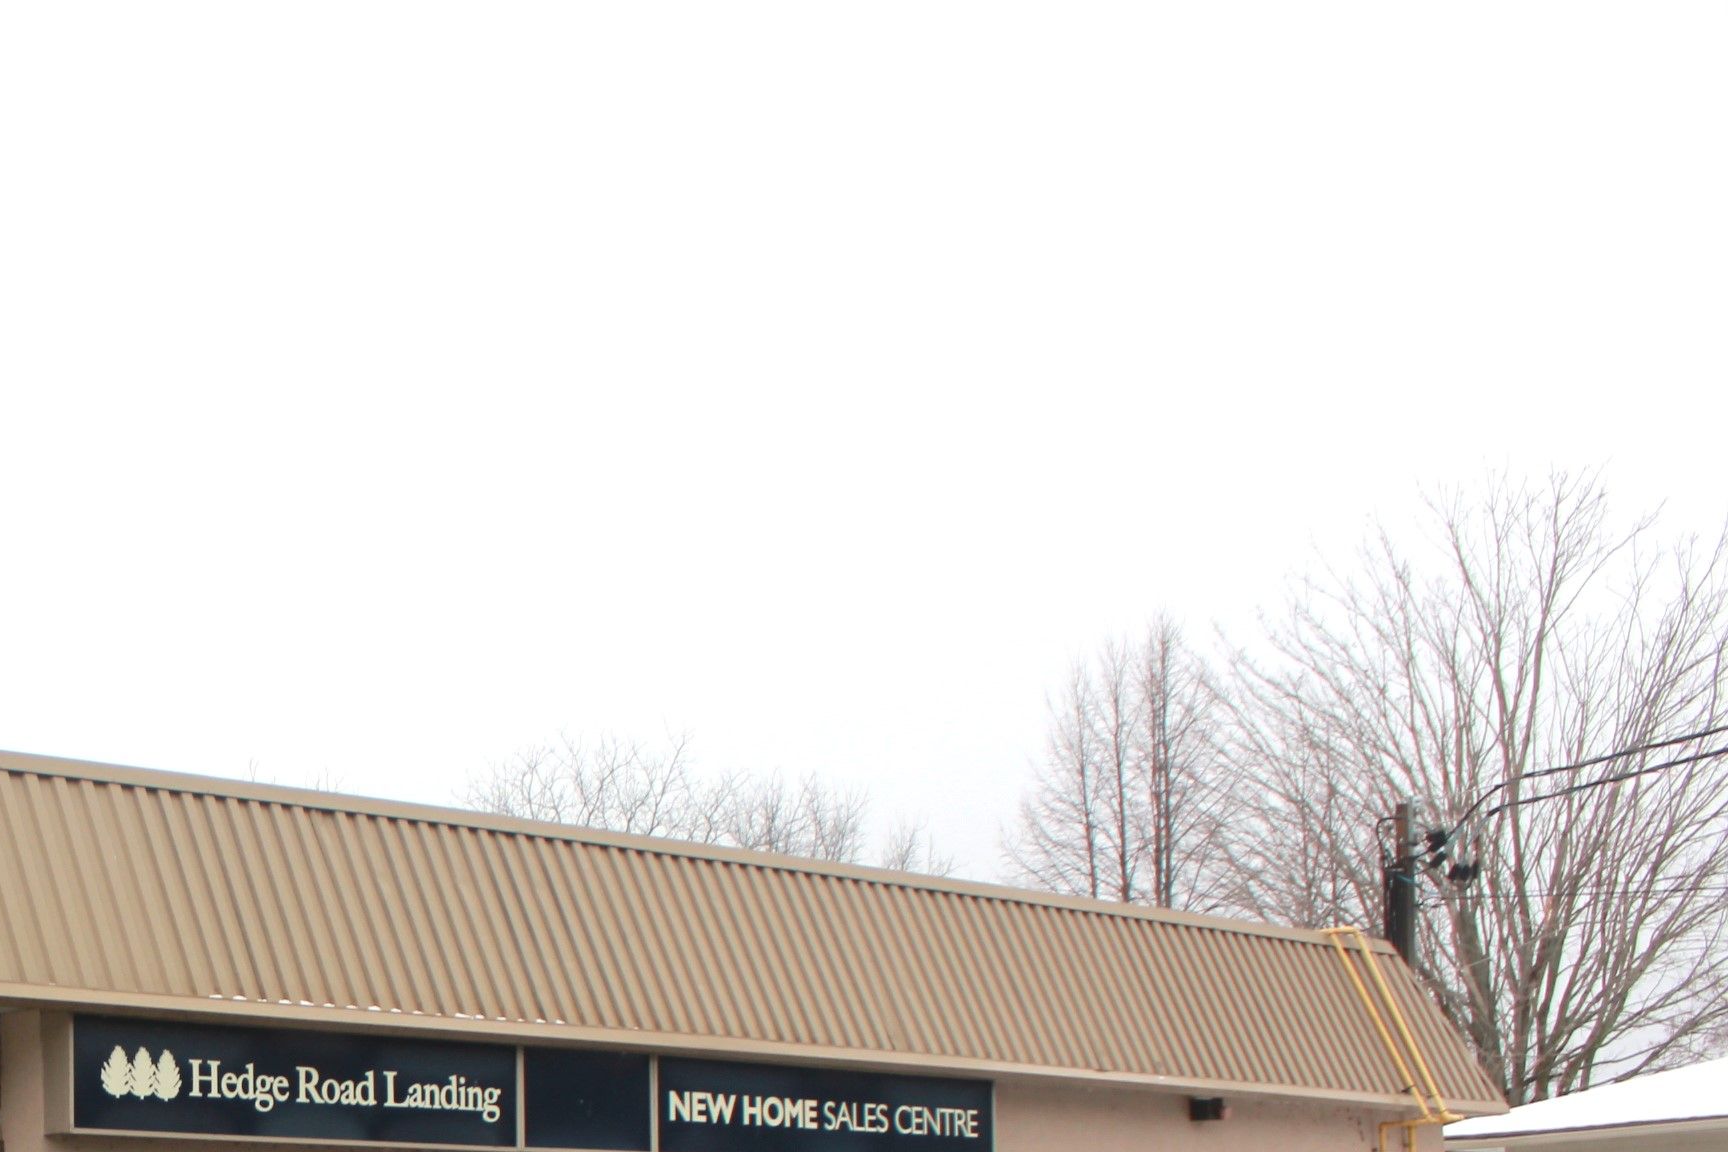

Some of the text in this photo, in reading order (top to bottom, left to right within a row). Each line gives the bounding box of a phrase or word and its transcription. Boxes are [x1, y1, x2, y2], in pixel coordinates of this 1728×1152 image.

[189, 1059, 502, 1123] Hedge Road Landing
[669, 1090, 979, 1138] NEW HOME SALES CENTRE
